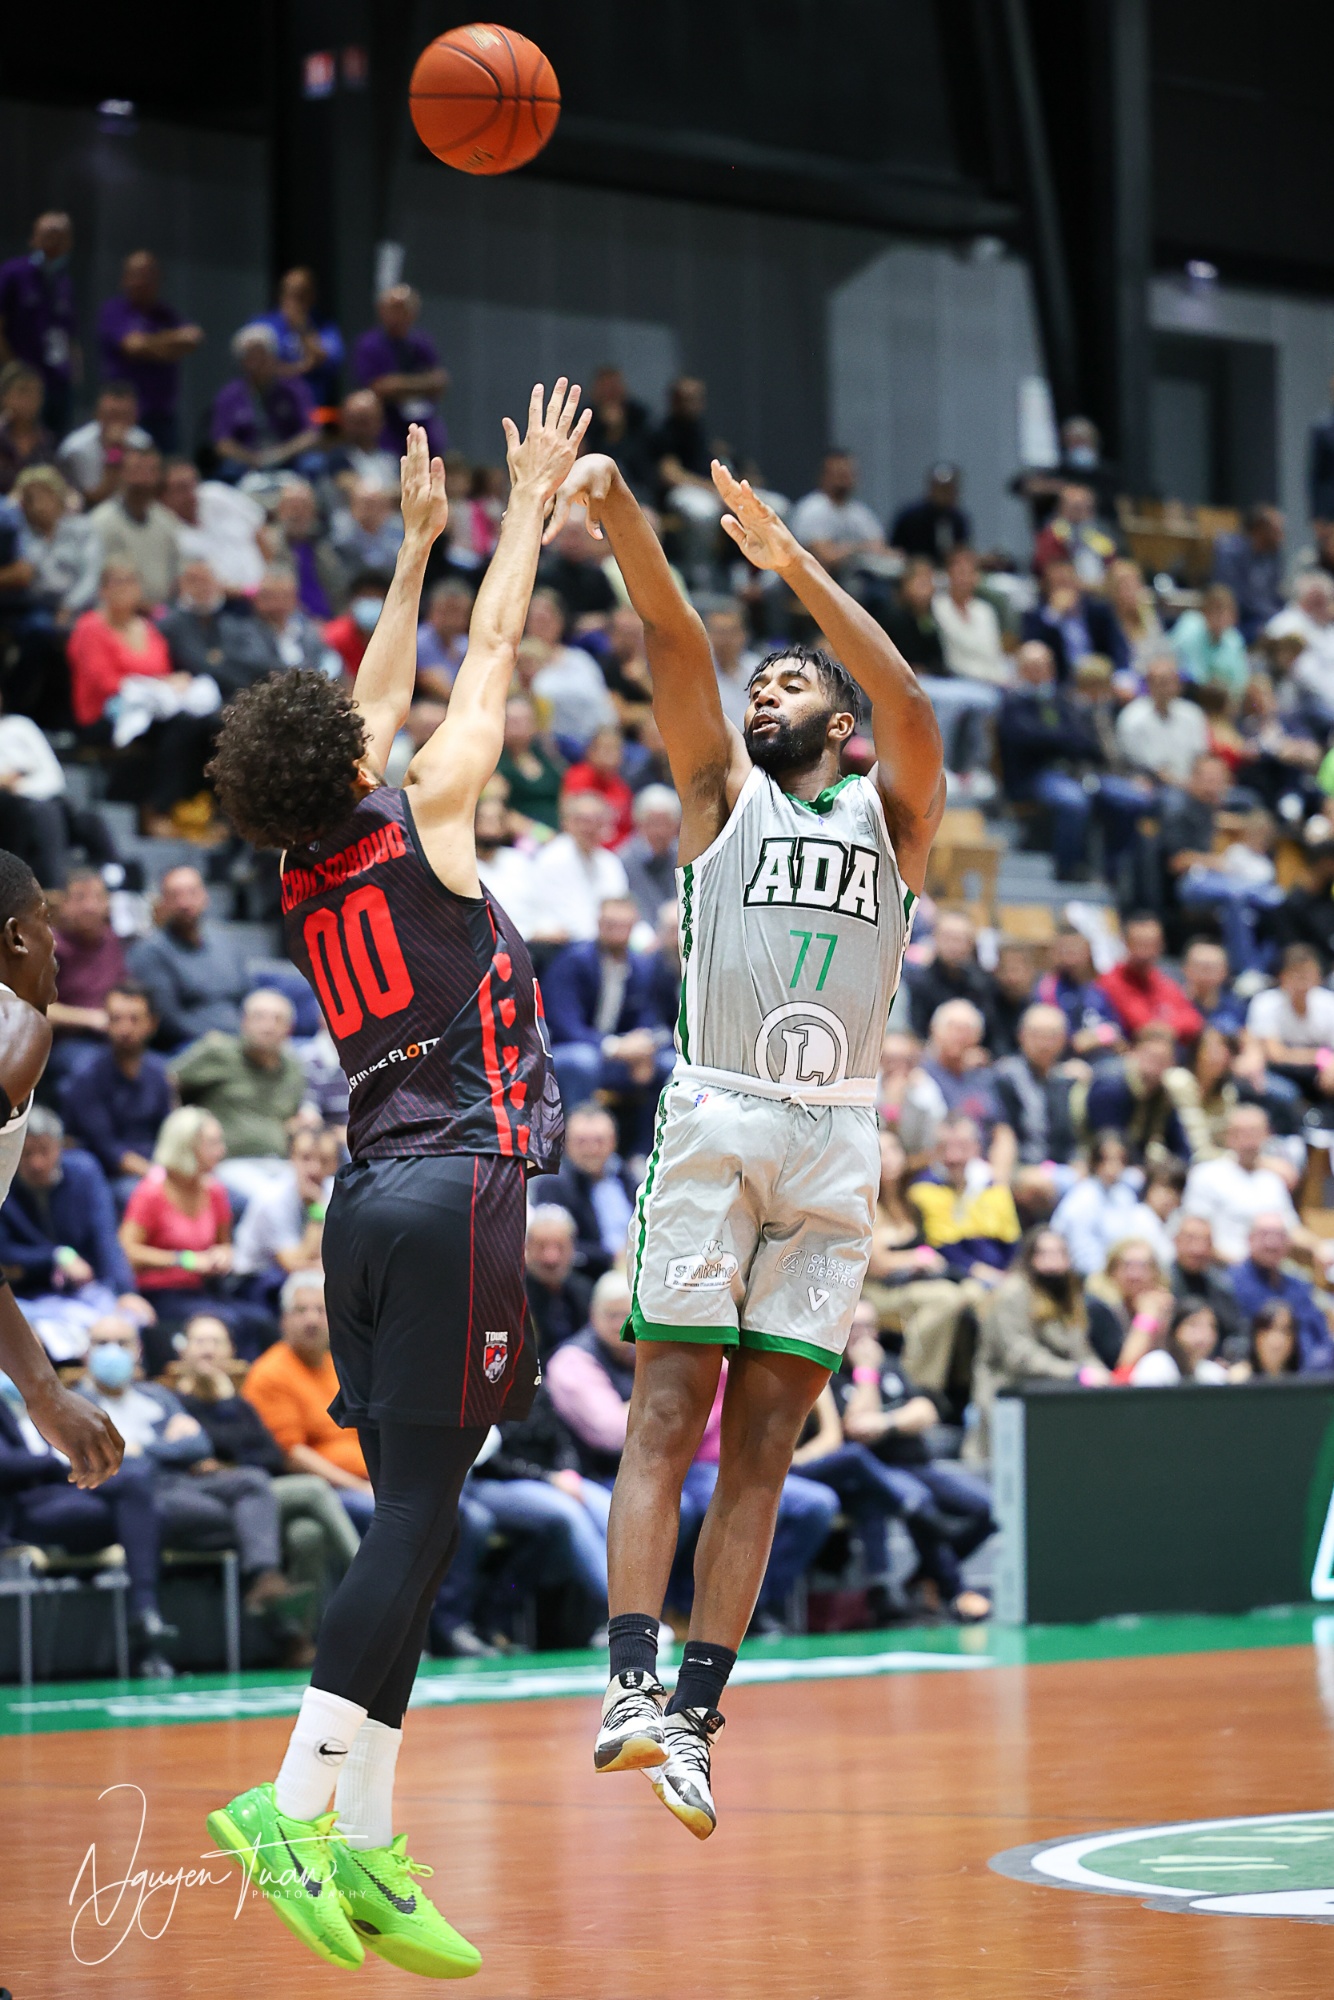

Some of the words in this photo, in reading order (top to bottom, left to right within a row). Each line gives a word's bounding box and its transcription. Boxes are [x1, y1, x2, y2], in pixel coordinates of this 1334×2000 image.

[743, 836, 881, 927] ADA
[303, 884, 415, 1040] 00
[789, 929, 838, 991] 77
[806, 1263, 860, 1289] D'EPARG
[810, 1252, 852, 1275] CAISSE
